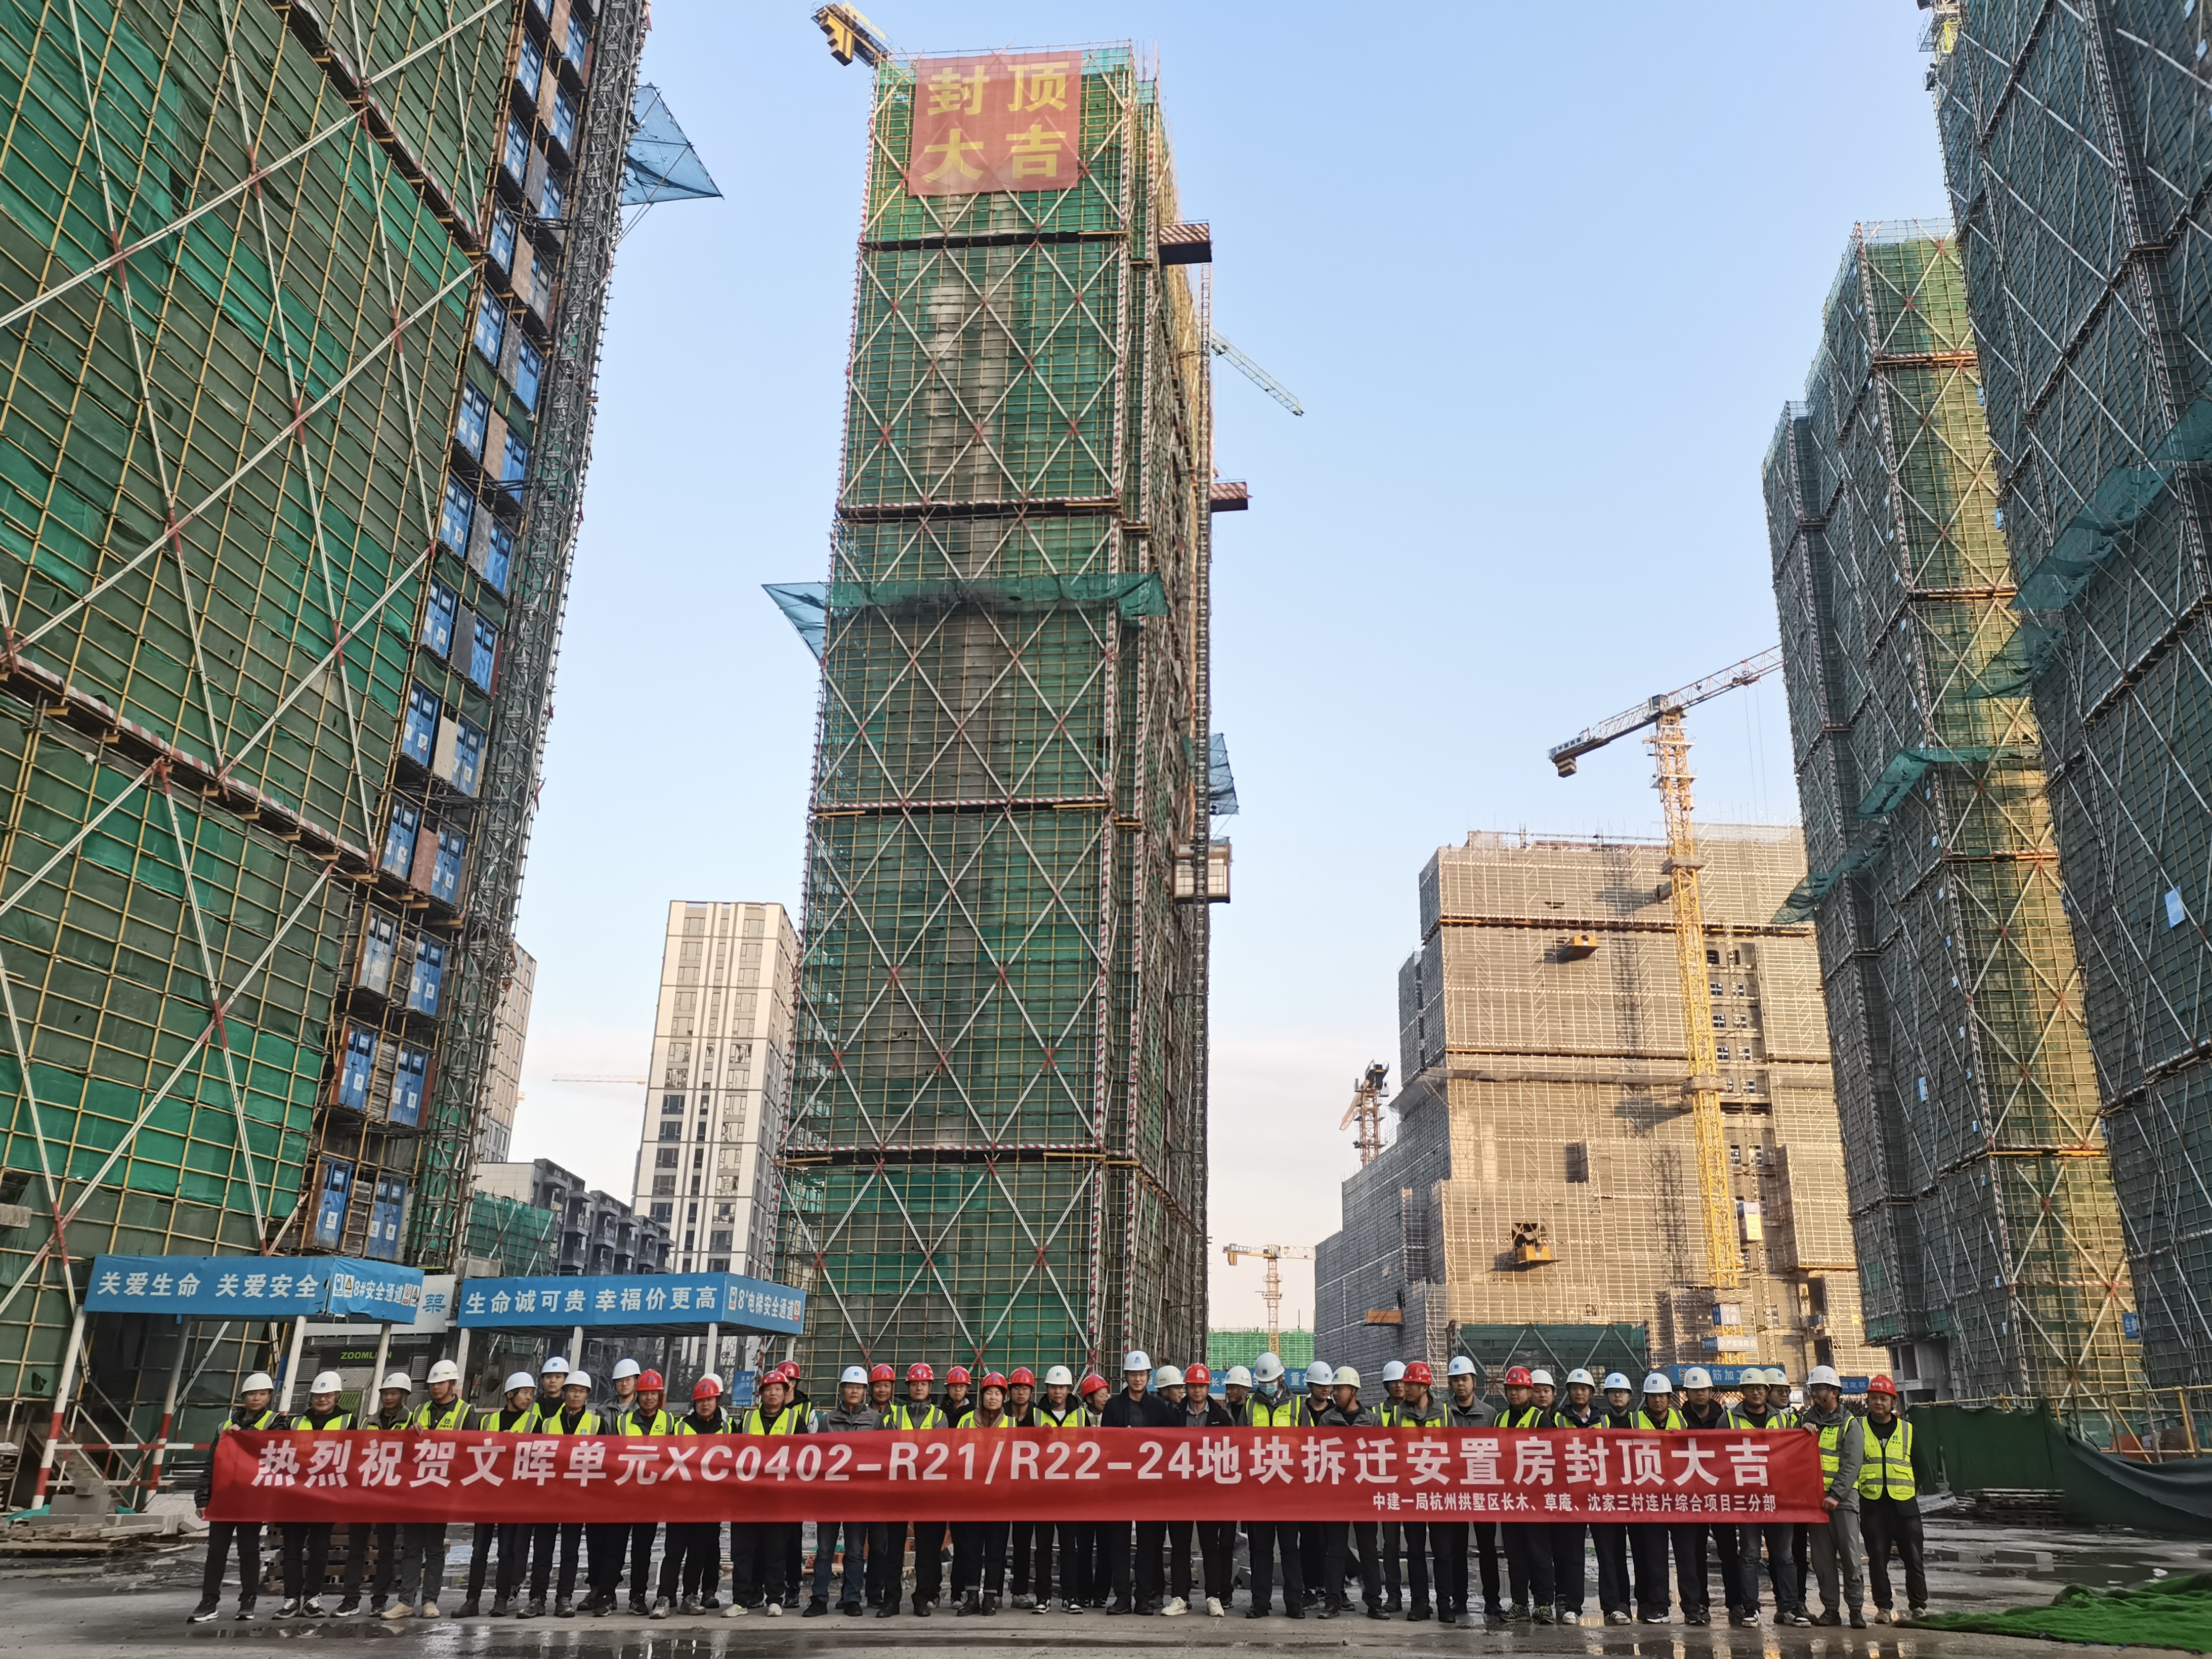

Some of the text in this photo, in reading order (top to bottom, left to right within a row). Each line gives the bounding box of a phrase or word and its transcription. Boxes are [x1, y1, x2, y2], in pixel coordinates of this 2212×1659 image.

[927, 61, 1070, 115] 封顶
[923, 124, 1066, 183] 大吉
[97, 1271, 319, 1298] 关爱生命 关爱安全
[353, 1280, 404, 1303] 8#安全通道
[465, 1286, 717, 1314] 生命诚可贵 幸福价更高
[1726, 1314, 1737, 1323] 1#
[340, 1351, 392, 1359] ZOOMLIN
